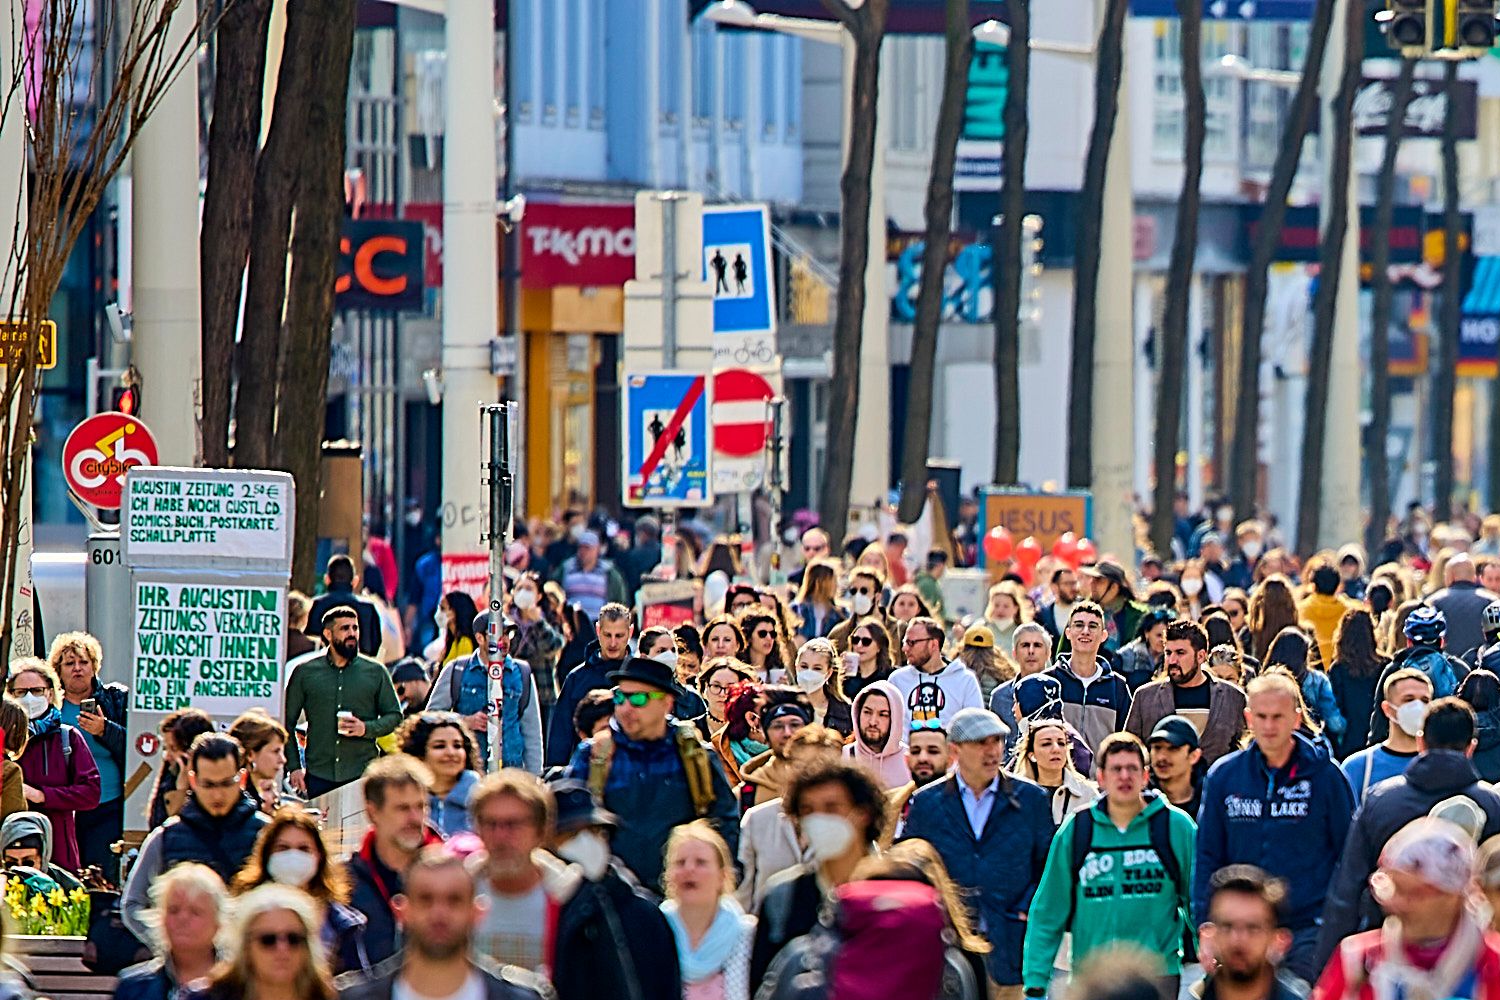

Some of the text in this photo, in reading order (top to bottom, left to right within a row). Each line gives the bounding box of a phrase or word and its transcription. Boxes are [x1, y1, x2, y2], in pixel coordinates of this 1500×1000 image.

[131, 481, 181, 496] AUGUSTIN
[186, 483, 234, 497] ZEITUNG
[131, 497, 149, 512] ICH
[154, 498, 184, 512] HABE
[188, 499, 221, 513] NOCH
[130, 529, 216, 543] SCHALLPLATTE
[138, 585, 277, 612] IHR AUGUSTIN
[138, 608, 207, 632] ZEITUNGS
[137, 632, 277, 660] WÜNSCHT IHNEN
[136, 657, 277, 682] FROHE OSTERN
[136, 679, 272, 698] UND EIN ANGENEHMES
[134, 696, 191, 711] LEBEN
[1270, 802, 1309, 817] LAKE
